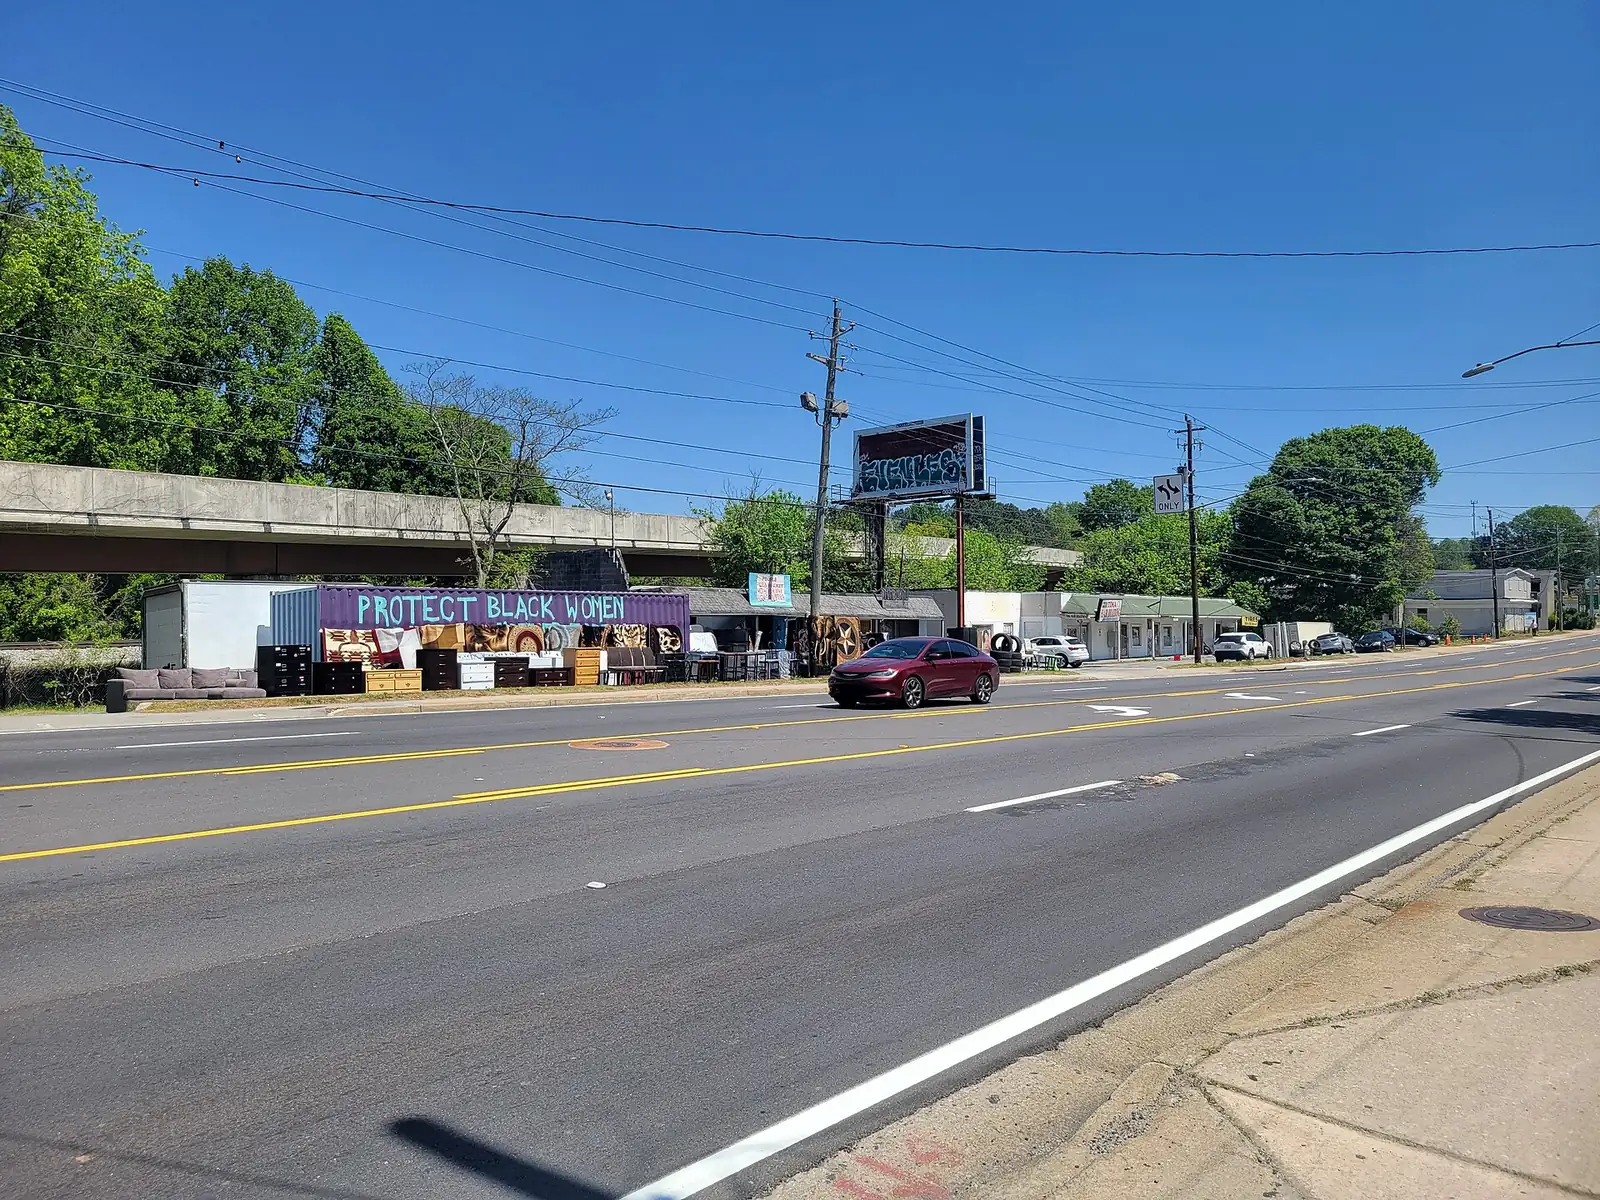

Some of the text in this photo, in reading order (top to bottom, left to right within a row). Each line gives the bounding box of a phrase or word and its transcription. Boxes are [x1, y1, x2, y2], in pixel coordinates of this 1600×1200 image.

[1158, 502, 1180, 510] ONLY
[358, 593, 625, 627] PROTECT BLACK WOMEN
